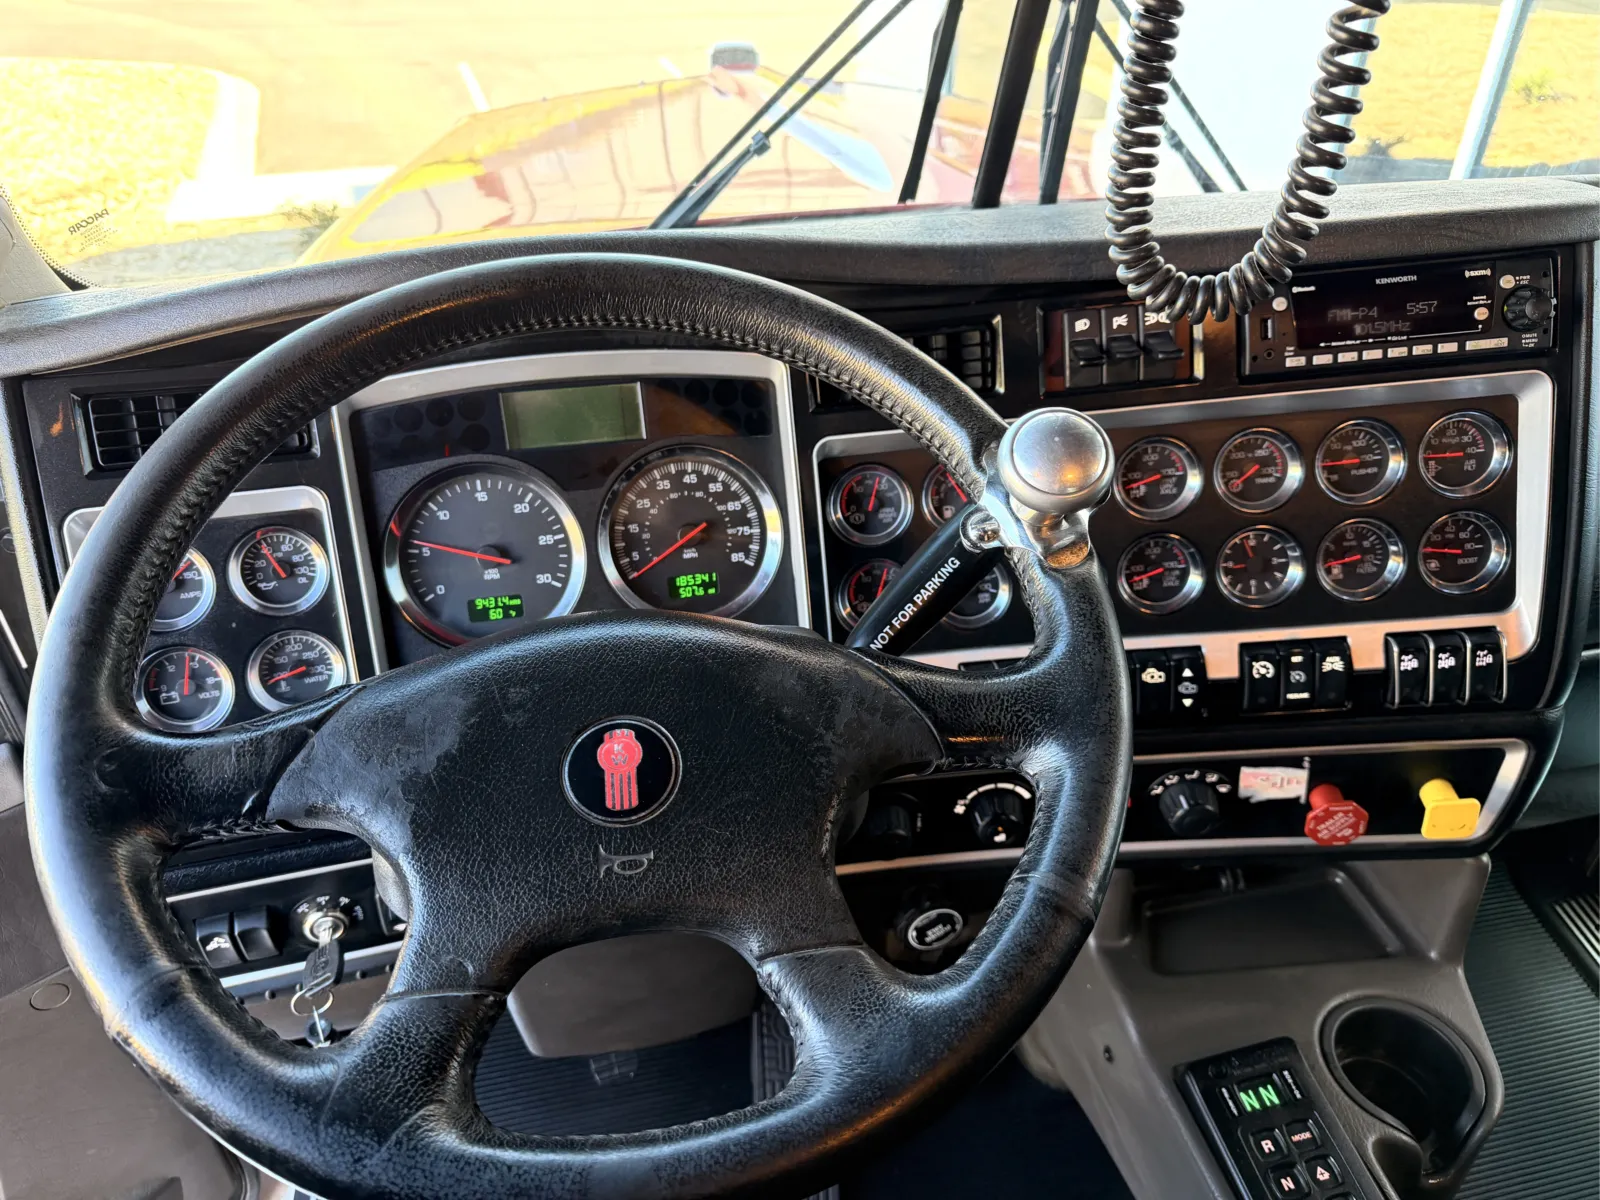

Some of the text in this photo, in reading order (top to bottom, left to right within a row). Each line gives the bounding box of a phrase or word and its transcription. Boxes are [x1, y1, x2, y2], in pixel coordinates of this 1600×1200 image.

[1375, 275, 1417, 285] KENWORTH
[1406, 300, 1437, 315] 5:57
[1350, 467, 1378, 475] PUSHER
[682, 473, 698, 484] 45
[656, 480, 671, 490] 35
[708, 482, 723, 493] 55
[474, 491, 489, 502] 15
[513, 502, 530, 514] 20
[636, 499, 651, 509] 25
[727, 501, 742, 512] 65
[436, 510, 450, 521] 10
[627, 523, 640, 534] 15
[736, 526, 751, 537] 75
[538, 534, 554, 546] 25
[281, 543, 294, 552] 60
[422, 548, 431, 557] 5
[292, 554, 304, 562] 80
[632, 552, 640, 561] 5
[682, 552, 699, 560] MPH
[730, 553, 746, 563] 85
[1457, 556, 1478, 565] BOOST
[254, 559, 267, 567] 20
[183, 570, 198, 579] 150
[294, 566, 310, 574] 100
[256, 572, 263, 580] 0
[483, 572, 500, 580] RPM
[536, 573, 552, 584] 30
[675, 572, 717, 587] 185341
[180, 590, 202, 599] AMPS
[436, 584, 445, 595] 0
[869, 556, 962, 651] NOT FOR PARKING
[489, 607, 503, 620] 60
[285, 642, 303, 652] 200
[274, 655, 289, 664] 150
[302, 650, 320, 660] 250
[167, 665, 176, 673] 12
[309, 664, 326, 674] 300
[205, 676, 215, 685] 18
[303, 674, 329, 684] WATER
[161, 684, 168, 692] 9
[198, 690, 221, 700] VOLTS
[1239, 1089, 1261, 1112] N
[1258, 1084, 1281, 1107] N
[1291, 1131, 1313, 1143] MODE
[1260, 1139, 1276, 1154] R
[1280, 1176, 1295, 1192] N
